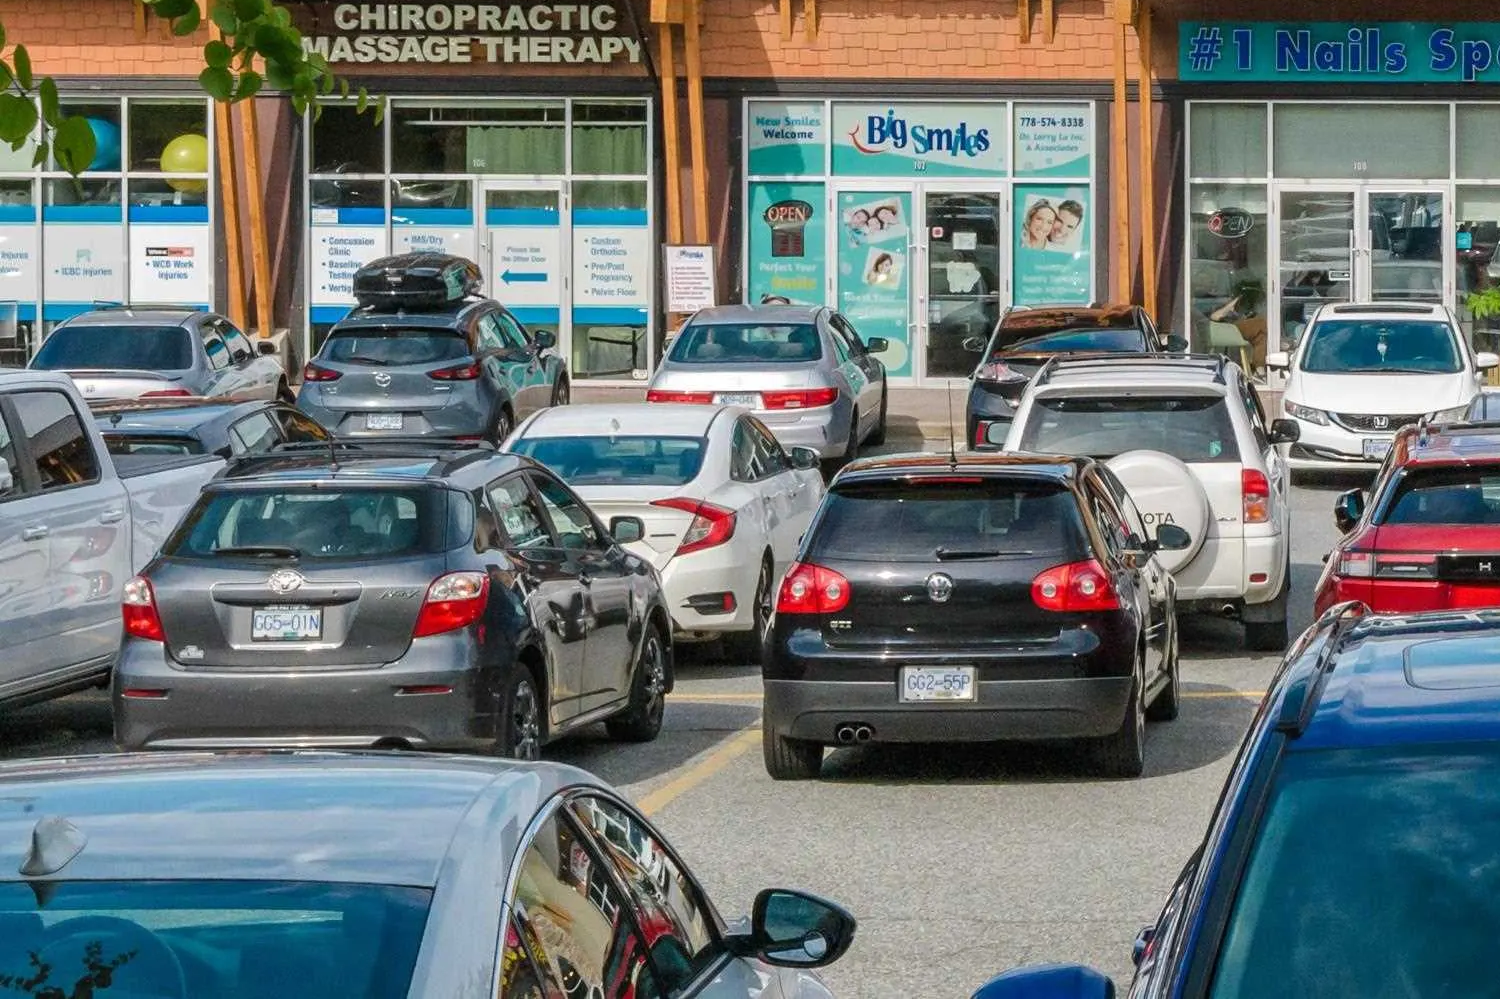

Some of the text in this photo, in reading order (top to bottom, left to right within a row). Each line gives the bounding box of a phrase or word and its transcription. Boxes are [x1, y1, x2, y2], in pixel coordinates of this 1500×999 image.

[333, 4, 617, 31] CHIROPRACTIC
[301, 36, 641, 63] MASSAGE THERAPY
[1188, 27, 1252, 72] #1
[1275, 27, 1408, 73] Nails
[784, 116, 821, 126] Smiles
[1019, 117, 1084, 127] 778-574-8338
[763, 129, 814, 139] Welcome
[867, 108, 990, 158] Big Smiles
[768, 206, 807, 222] OPEN
[329, 236, 375, 246] Concussion
[591, 237, 622, 245] Custom
[328, 247, 351, 256] Clinic
[591, 248, 627, 256] Orthotics
[173, 259, 194, 268] Work
[328, 271, 352, 279] Testin
[591, 273, 632, 284] Pregnancy
[328, 284, 352, 293] Vertig
[254, 614, 320, 631] GG5-01N
[907, 674, 971, 691] GG2-55P
